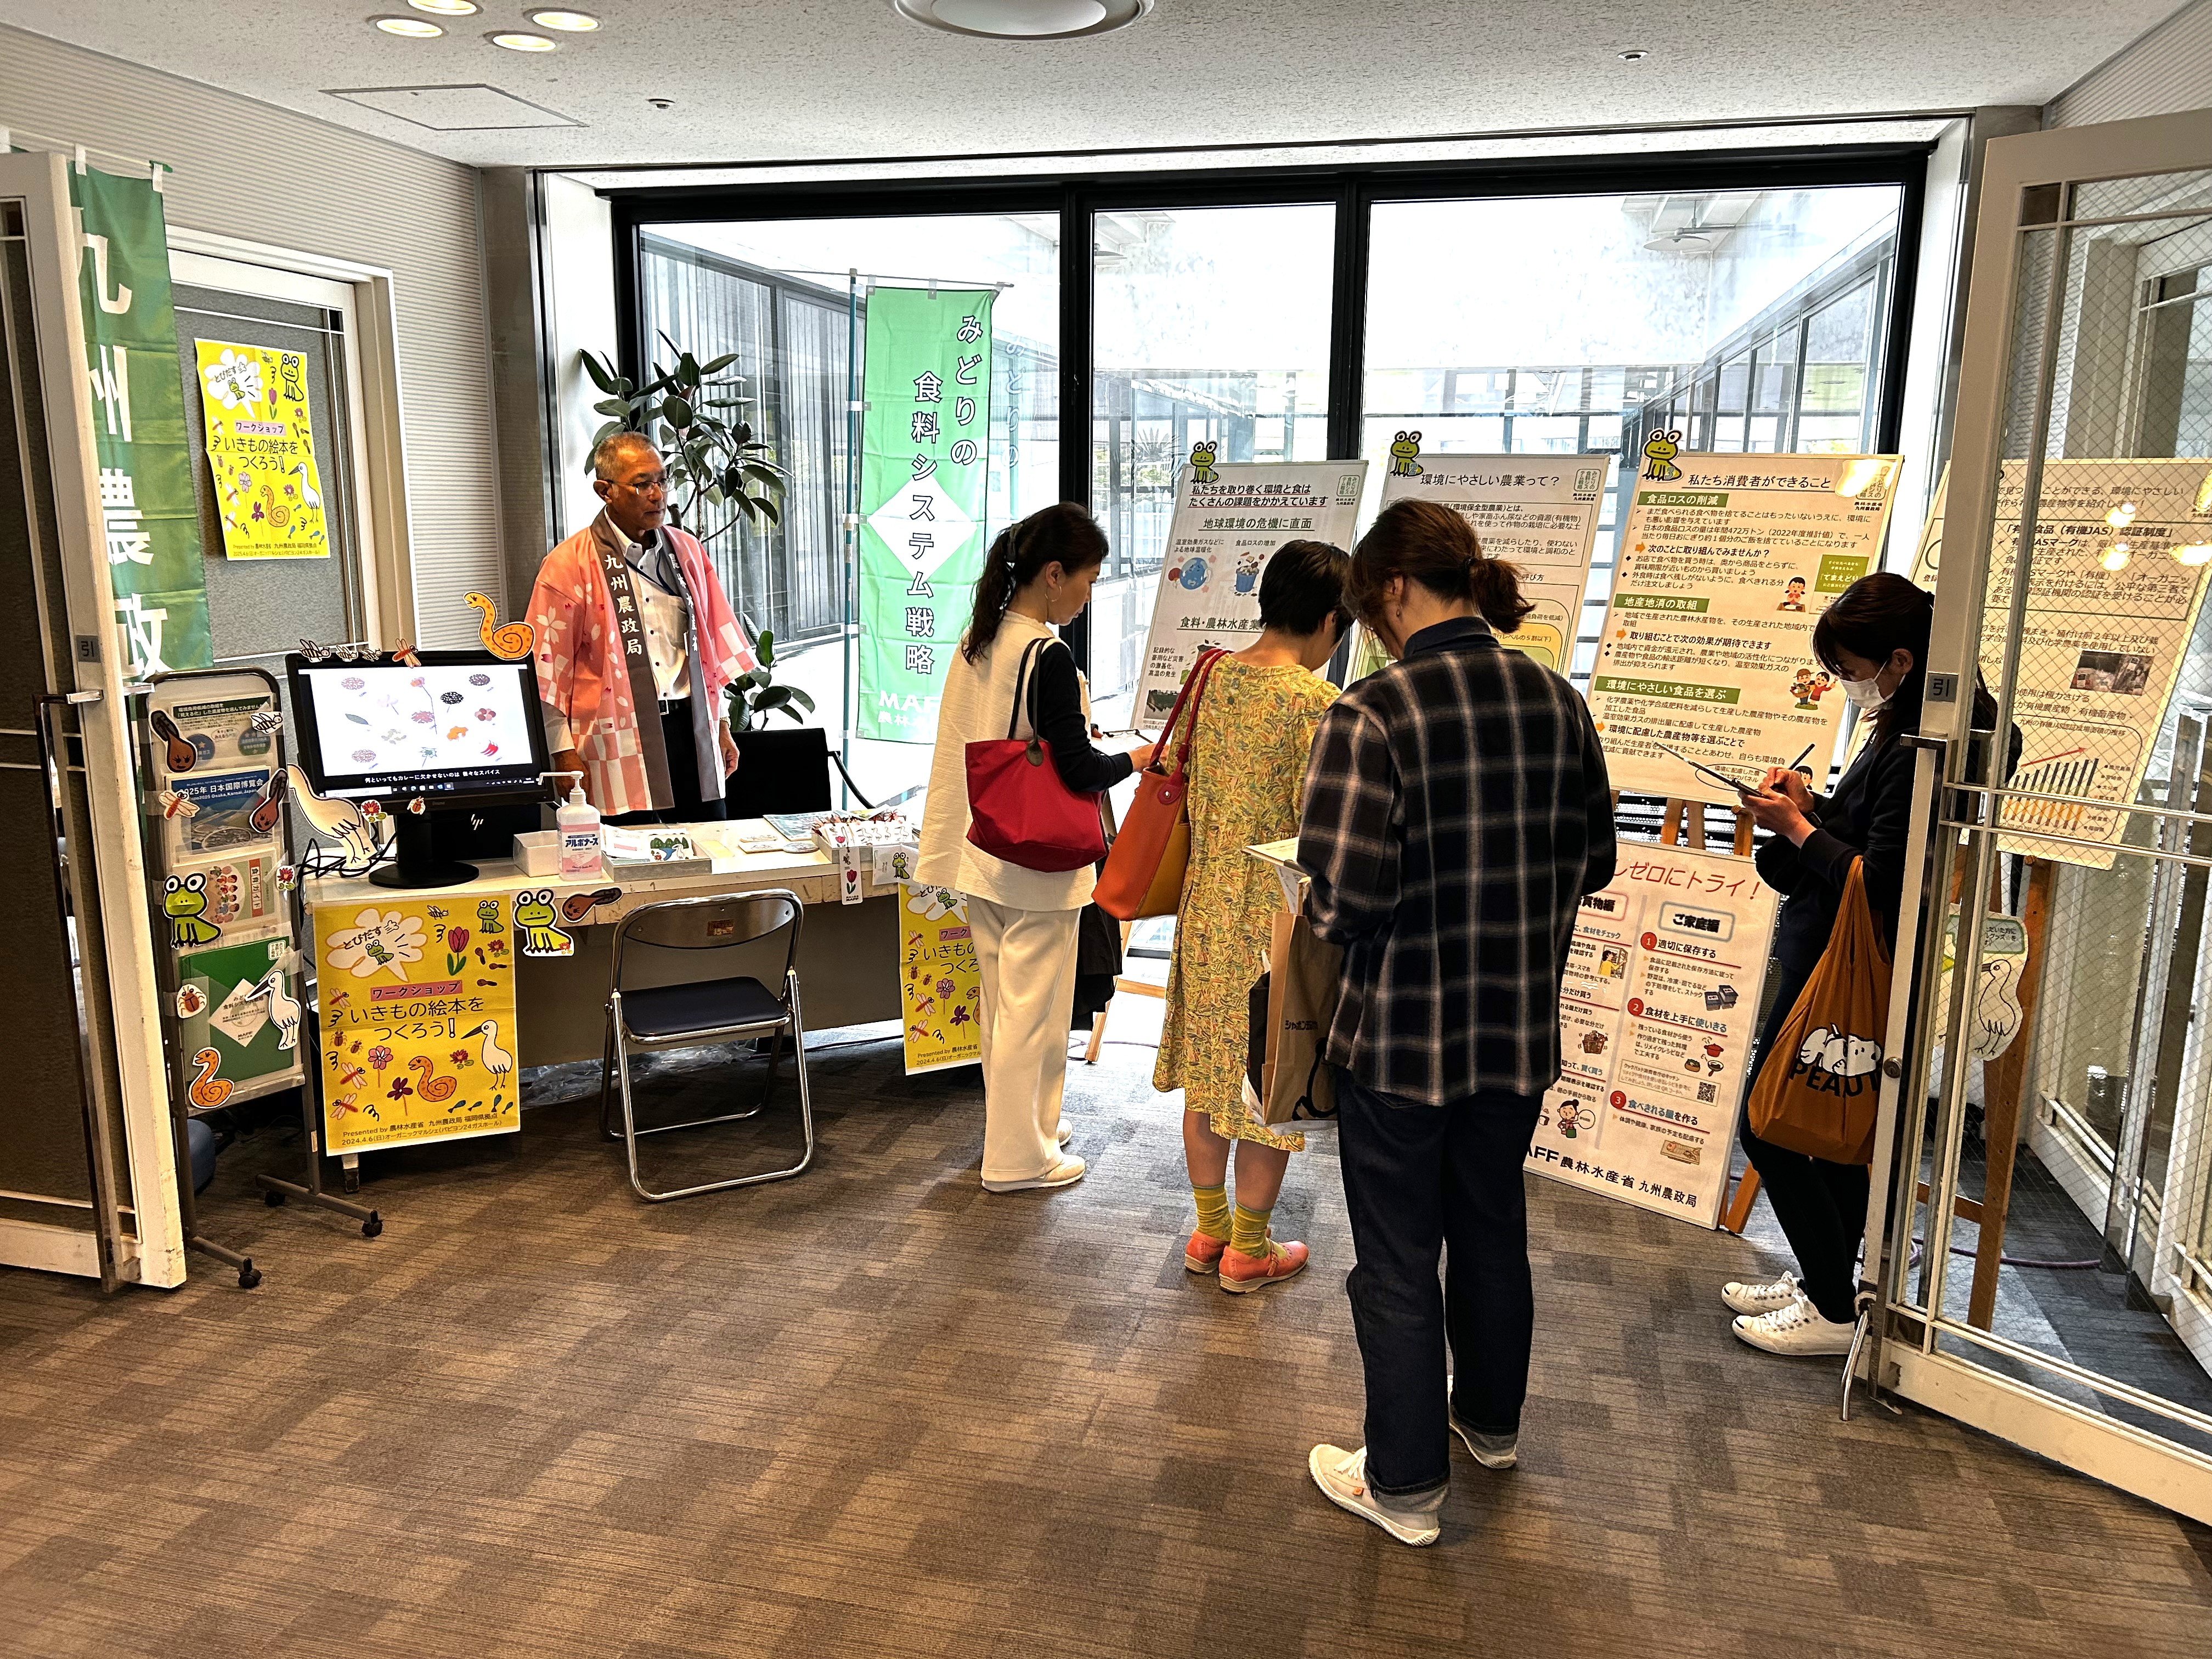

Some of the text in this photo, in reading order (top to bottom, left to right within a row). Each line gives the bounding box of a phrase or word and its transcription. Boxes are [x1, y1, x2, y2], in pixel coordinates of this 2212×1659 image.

[214, 365, 237, 383] とびだす
[950, 314, 983, 466] みどりの
[236, 422, 284, 434] ワークショップ
[225, 437, 298, 455] いきもの絵本を
[1420, 473, 1560, 487] 環境にやさしい農業って？
[1688, 473, 1831, 489] 私たち消費者ができること
[1191, 484, 1312, 495] 私たちを取り巻く環境と食は
[1188, 495, 1329, 507] たくさんの課題をかかえています
[1646, 493, 1719, 506] 食品ロスの削減
[905, 371, 943, 675] 食料システム戦略
[1203, 517, 1313, 529] 地球環境の危機に直面
[1645, 516, 1731, 525] も悪い影響を与えています
[1630, 579, 1693, 590] だけ注文しましょう
[603, 554, 643, 656] 九州農政局
[1624, 596, 1698, 611] 地産地消の取組
[81, 640, 95, 657] 引
[1629, 631, 1772, 650] 取り組むことで次の効果が期待できます
[1152, 654, 1184, 663] 豪雨など災害
[1612, 659, 1676, 670] 排出が抑えられます
[1606, 679, 1727, 700] 環境にやさしい食品を選ぶ
[1932, 679, 1950, 697] 引
[1604, 704, 1646, 715] 加工した食品
[1609, 724, 1745, 748] 環境に配慮した農産物等を選ぶことで
[210, 778, 264, 793] 日本国際博覧会
[565, 837, 599, 848] アルボナース
[1672, 913, 1721, 933] ご家庭編
[343, 924, 383, 950] とびだす
[941, 928, 968, 939] ワーク
[1657, 939, 1717, 958] 適切に保存する
[940, 957, 980, 974] つくろ
[1648, 964, 1669, 974] 保存する
[1649, 956, 1735, 980] 食品に記載された保存方法に従って
[371, 980, 460, 999] ワークショップ
[351, 996, 485, 1024] いきもの絵本を
[1645, 1007, 1727, 1033] 食材を上手に使いきる
[1638, 1023, 1692, 1042] 残っている食材から使う
[1637, 1033, 1688, 1051] 作り過ぎて残った料理
[917, 1049, 944, 1059] Presented
[951, 1044, 978, 1053] 農林水産省
[1634, 1048, 1660, 1060] で工夫する
[1628, 1099, 1700, 1126] 食べきれる量を作る
[343, 1127, 378, 1137] Presented
[389, 1121, 424, 1132] 農林水産省
[428, 1116, 463, 1127] 九州農政局
[464, 1113, 498, 1122] 福岡県拠点
[1560, 1155, 1635, 1189] 農林水産省
[1638, 1180, 1697, 1209] 九州農政局
